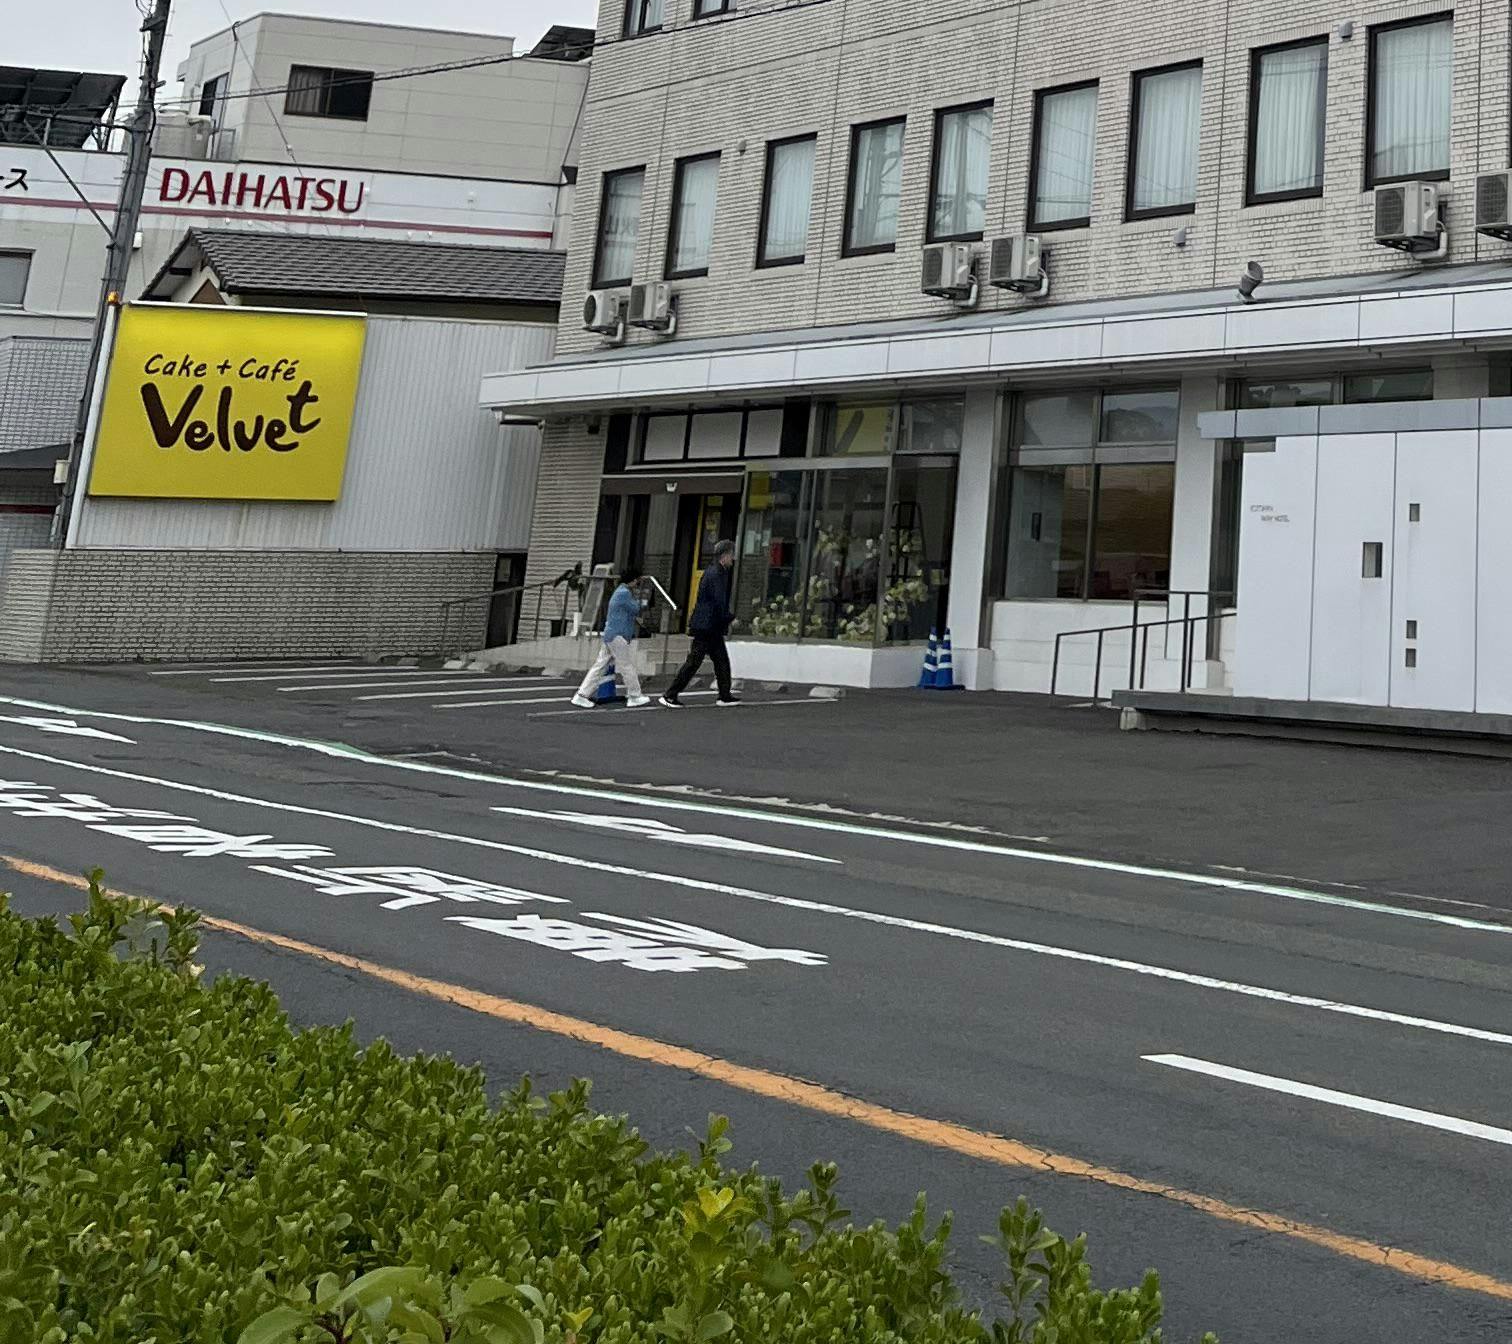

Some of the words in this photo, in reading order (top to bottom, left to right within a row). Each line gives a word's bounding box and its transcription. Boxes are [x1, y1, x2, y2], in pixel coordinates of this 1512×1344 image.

[159, 167, 364, 213] DAIHATSU
[144, 353, 208, 378] Cake
[216, 359, 232, 375] +
[238, 358, 299, 381] Café
[140, 380, 322, 453] Velvet
